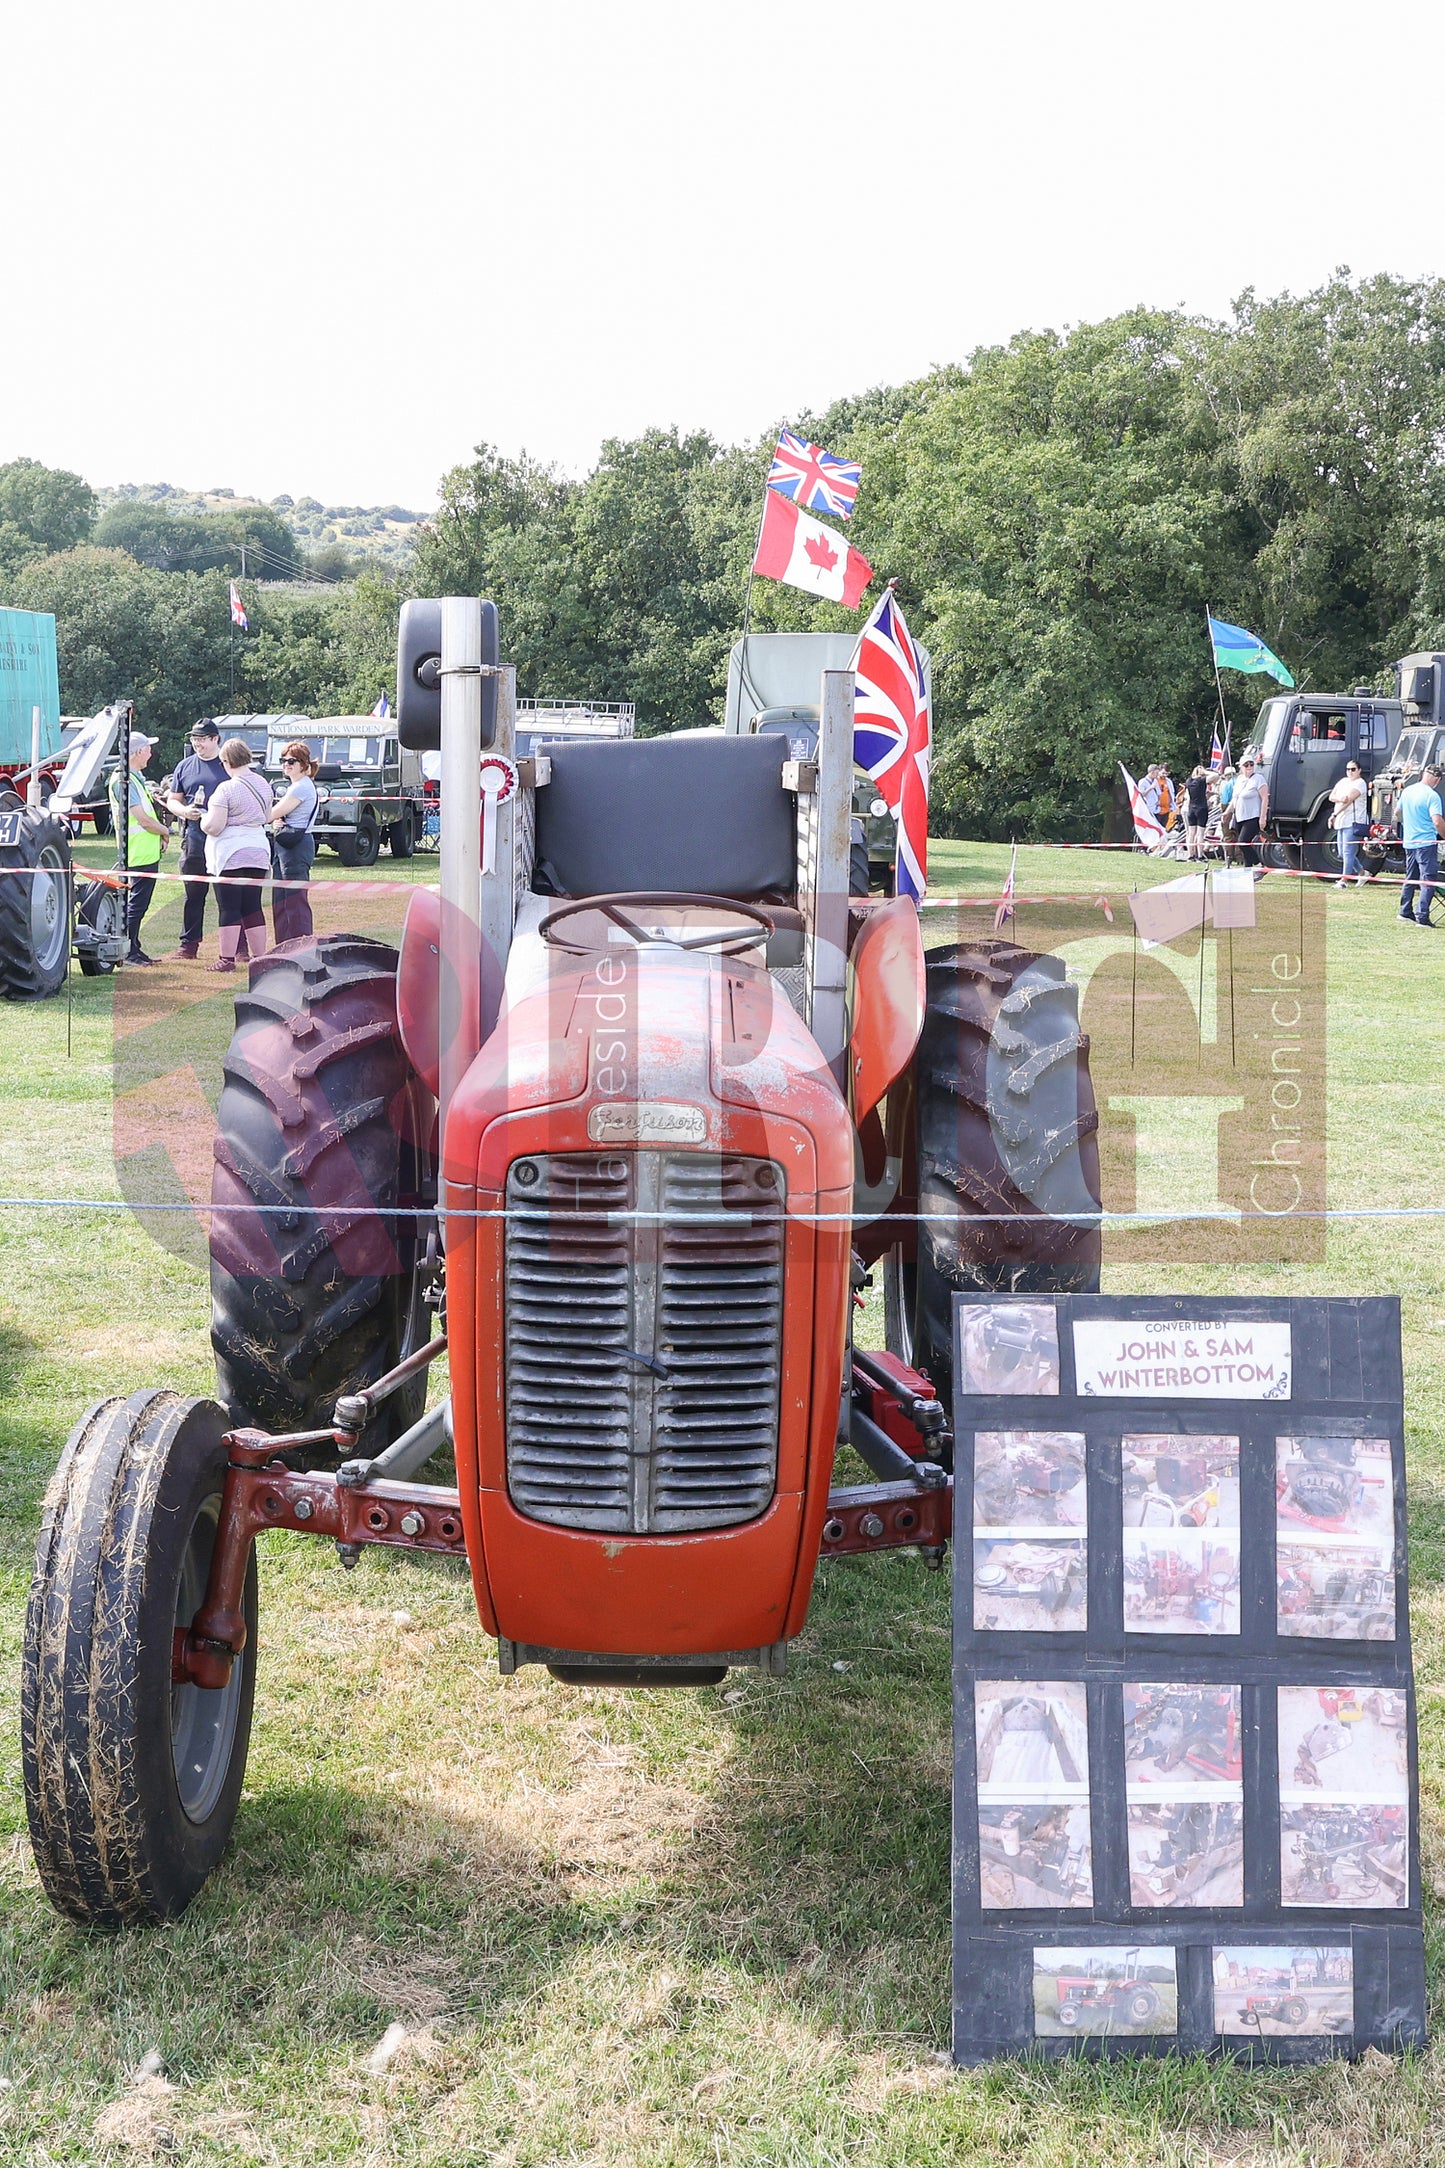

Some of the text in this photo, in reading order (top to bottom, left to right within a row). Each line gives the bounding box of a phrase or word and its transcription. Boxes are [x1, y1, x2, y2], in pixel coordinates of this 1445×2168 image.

[271, 725, 381, 733] NATIONAL PARK WARDEN
[0, 815, 13, 828] 7
[594, 1109, 703, 1139] Ferguson
[1145, 1321, 1228, 1333] CONVERTED BY
[1116, 1337, 1254, 1362] JOHN & SAM
[1097, 1363, 1275, 1389] WINTERBOTTOM
